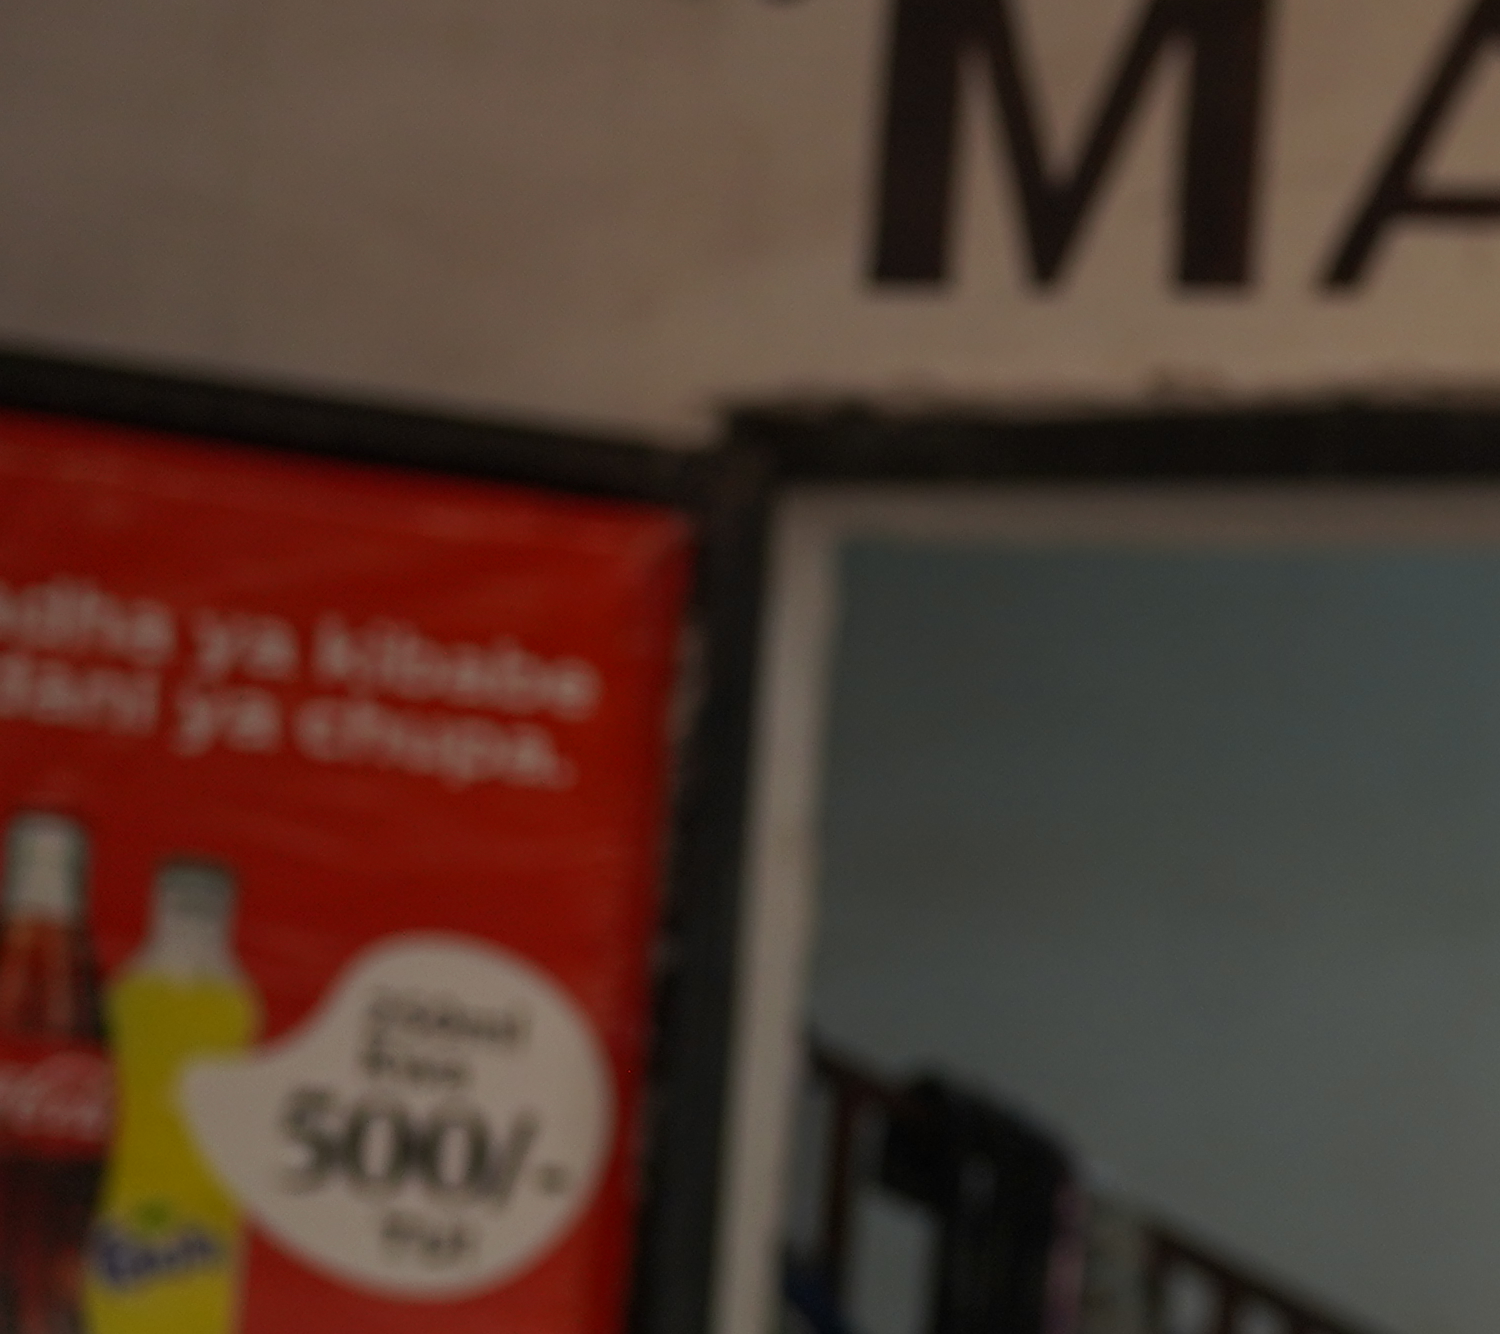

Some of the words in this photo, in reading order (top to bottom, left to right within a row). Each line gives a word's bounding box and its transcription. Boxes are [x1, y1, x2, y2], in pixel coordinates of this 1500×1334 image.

[190, 607, 297, 679] ya
[170, 685, 283, 756] ya
[279, 1085, 567, 1209] 500/-
